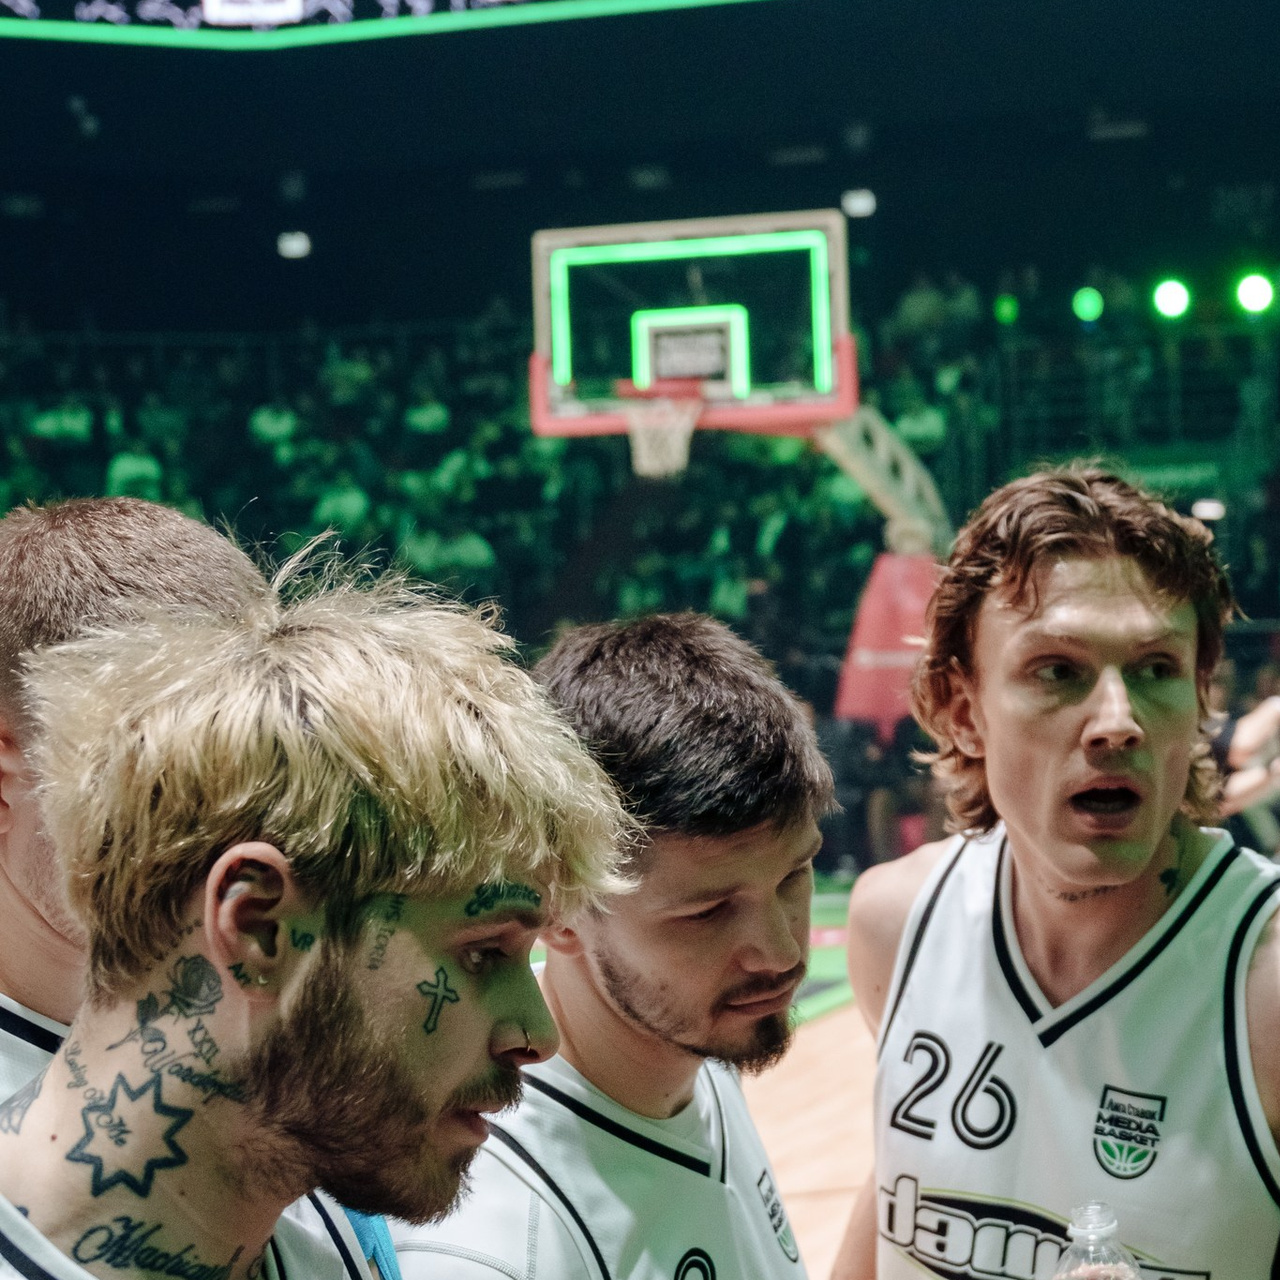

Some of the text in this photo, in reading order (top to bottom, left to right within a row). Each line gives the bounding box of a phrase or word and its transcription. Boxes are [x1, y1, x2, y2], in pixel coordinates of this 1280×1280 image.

[890, 1028, 1018, 1151] 26
[1094, 1124, 1160, 1148] BASKET
[1096, 1111, 1160, 1137] MEDIA
